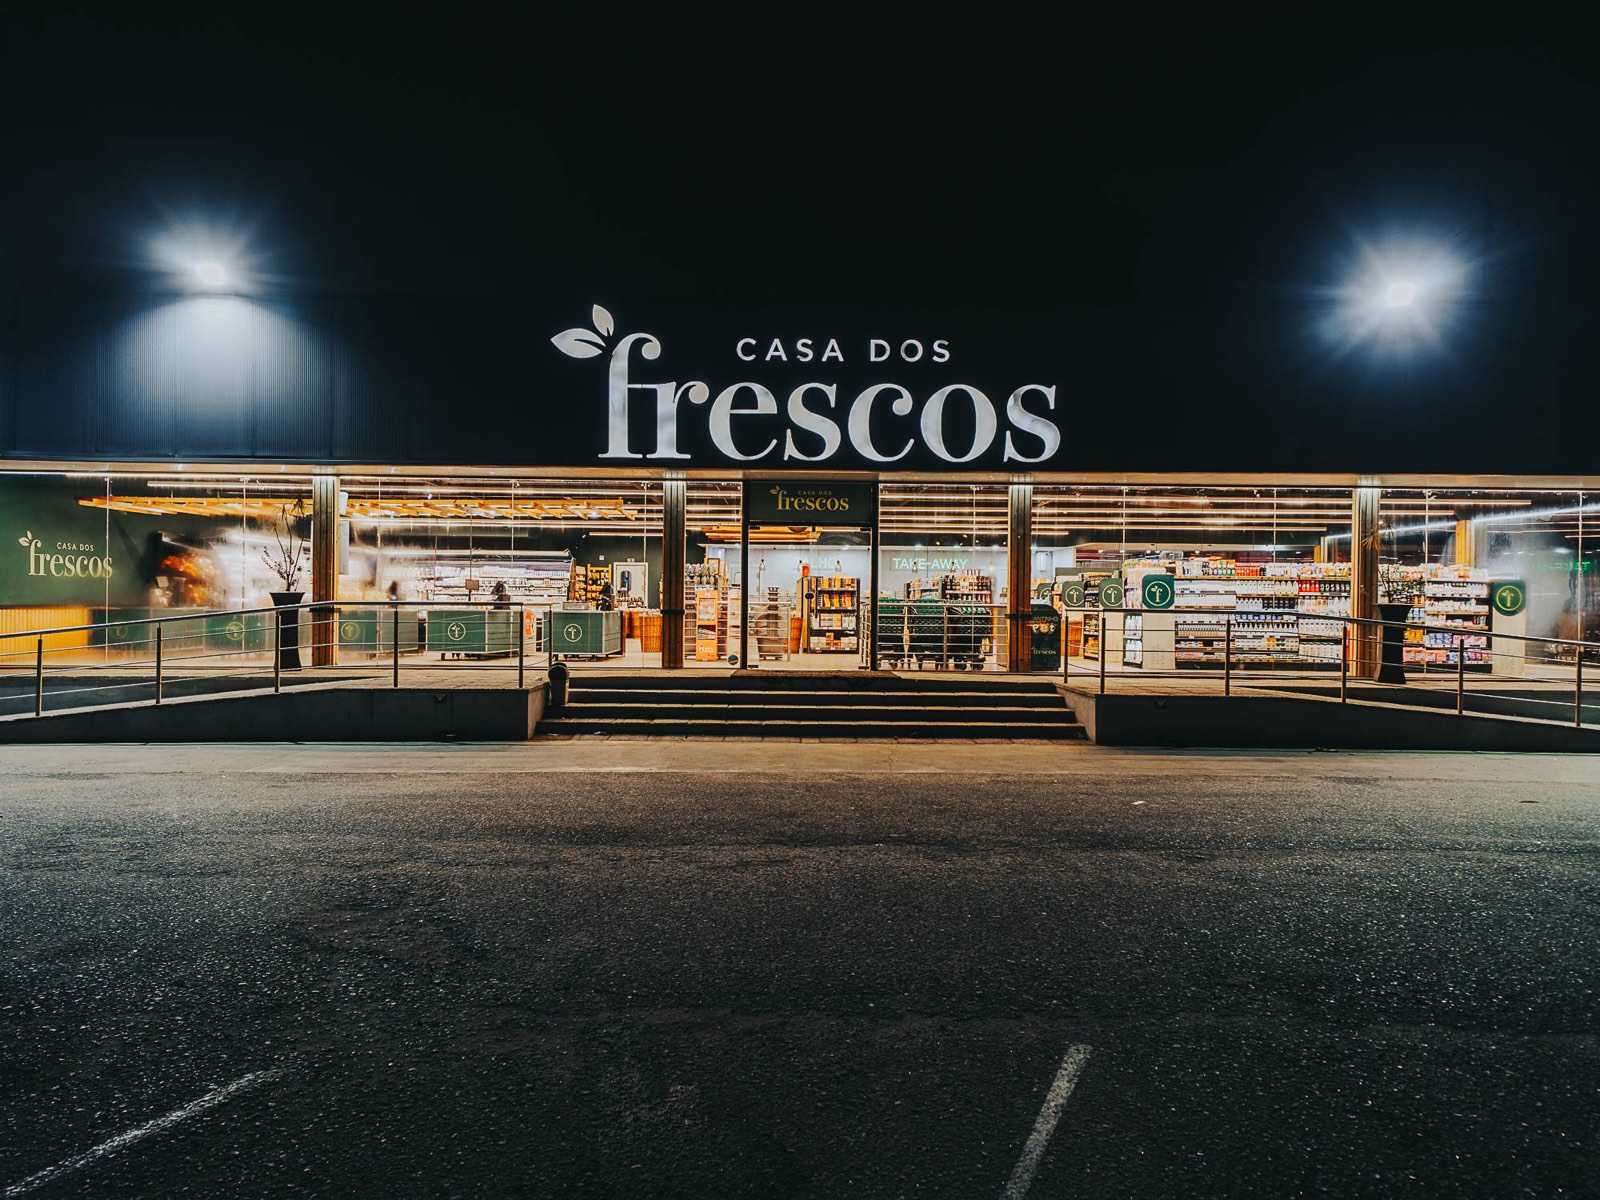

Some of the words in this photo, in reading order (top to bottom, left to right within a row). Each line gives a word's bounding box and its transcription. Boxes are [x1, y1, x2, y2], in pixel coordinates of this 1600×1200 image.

[736, 337, 845, 363] CASA
[869, 339, 952, 363] DOS
[597, 332, 1062, 463] frescos
[777, 489, 849, 511] frescos
[27, 539, 113, 578] frescos
[56, 541, 77, 551] CASA
[79, 543, 95, 552] DOS
[892, 558, 968, 570] TAKE-AWAY
